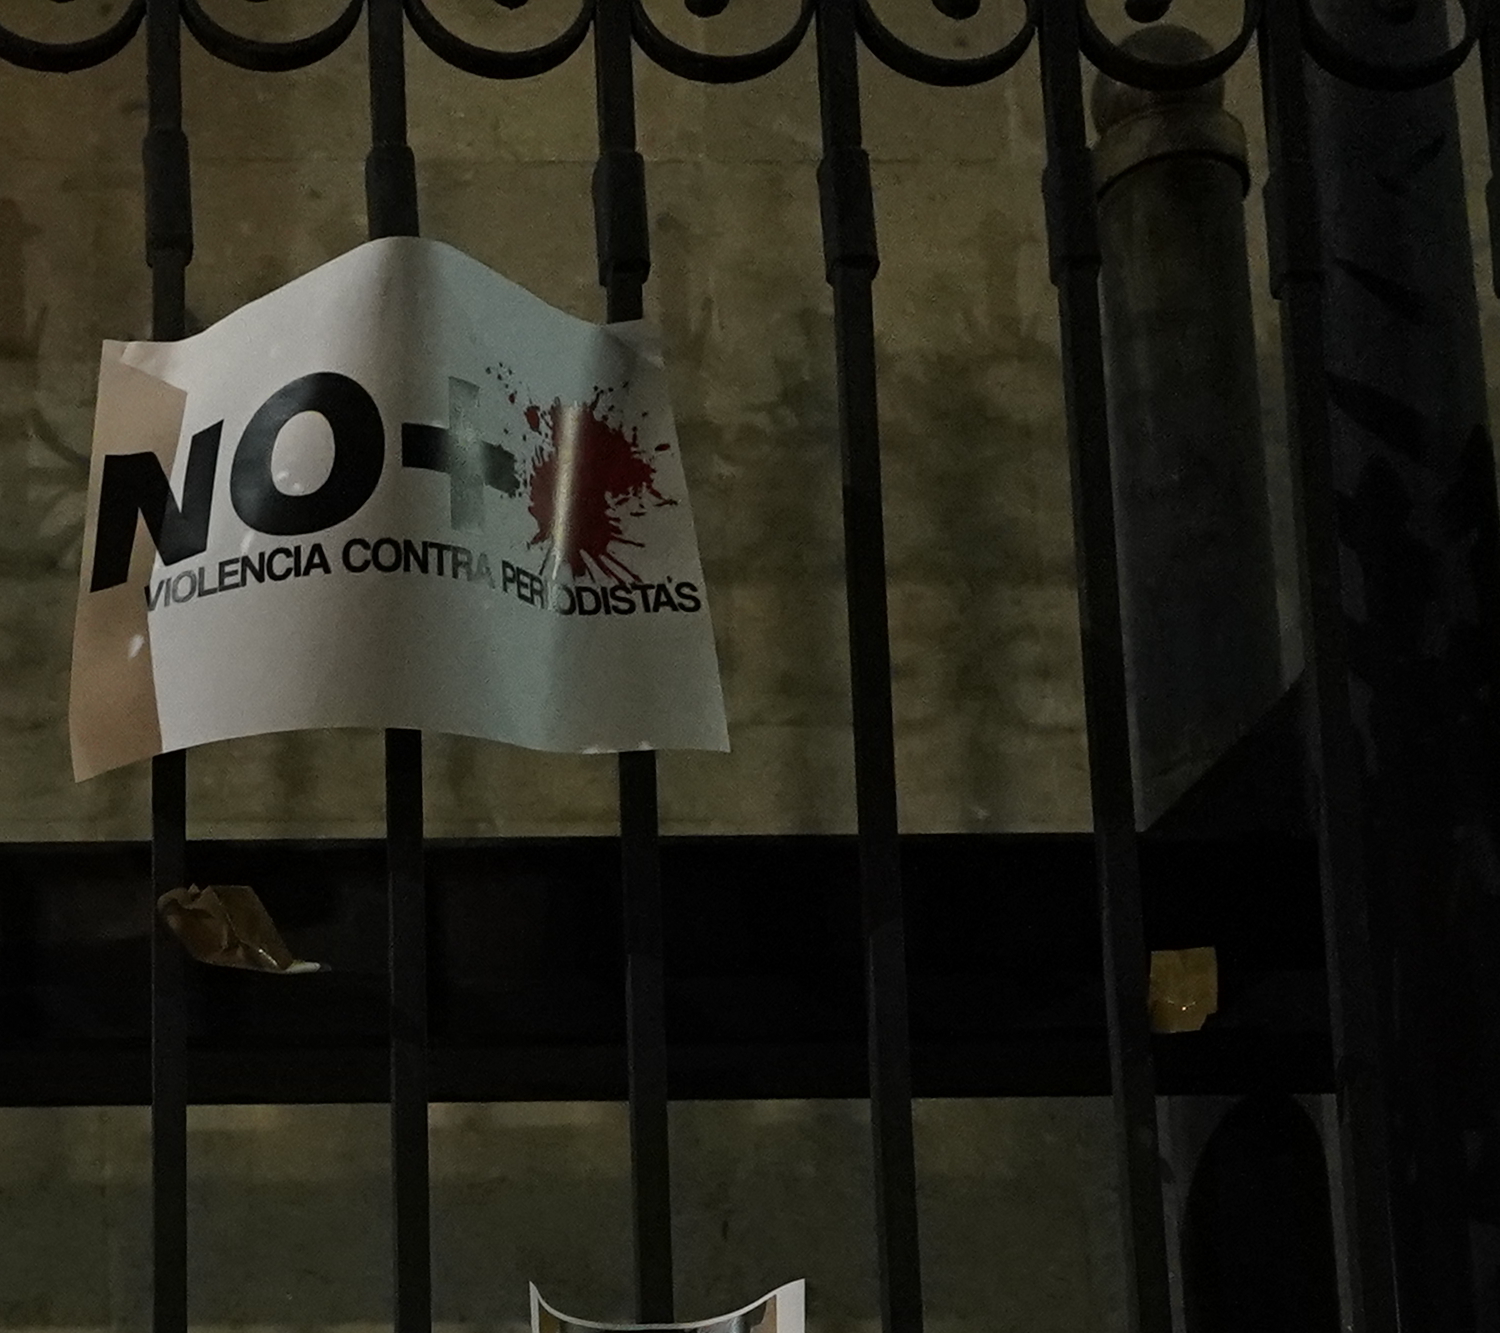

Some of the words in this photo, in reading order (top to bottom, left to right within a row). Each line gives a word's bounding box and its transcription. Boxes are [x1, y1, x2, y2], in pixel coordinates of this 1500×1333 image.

[143, 542, 332, 612] VIOLENCIA
[341, 536, 496, 589] CONTRA
[501, 558, 701, 616] PERODISTAS
